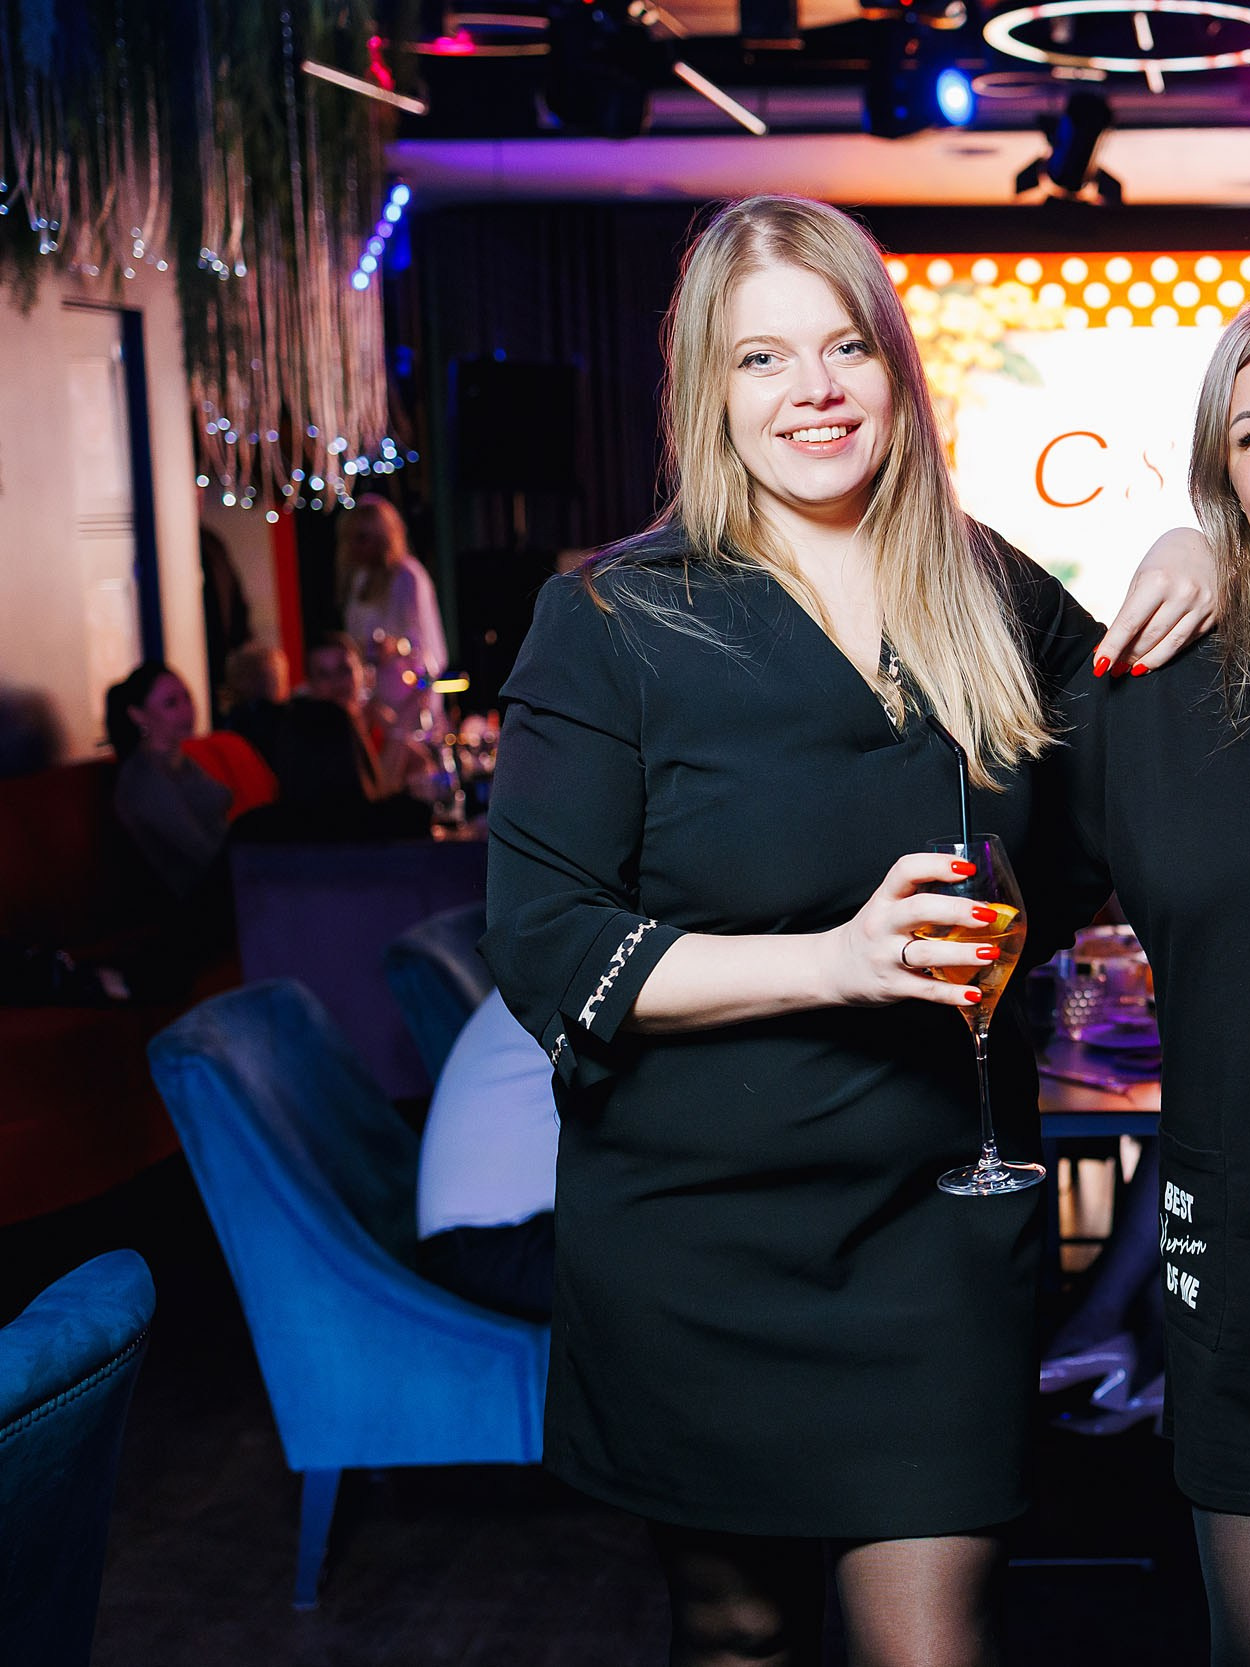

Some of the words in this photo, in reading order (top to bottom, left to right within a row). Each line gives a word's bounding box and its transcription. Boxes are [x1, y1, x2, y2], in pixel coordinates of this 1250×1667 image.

[1164, 1181, 1194, 1224] BEST
[1159, 1212, 1207, 1257] Version
[1166, 1262, 1179, 1295] OF
[1179, 1272, 1200, 1310] ME
